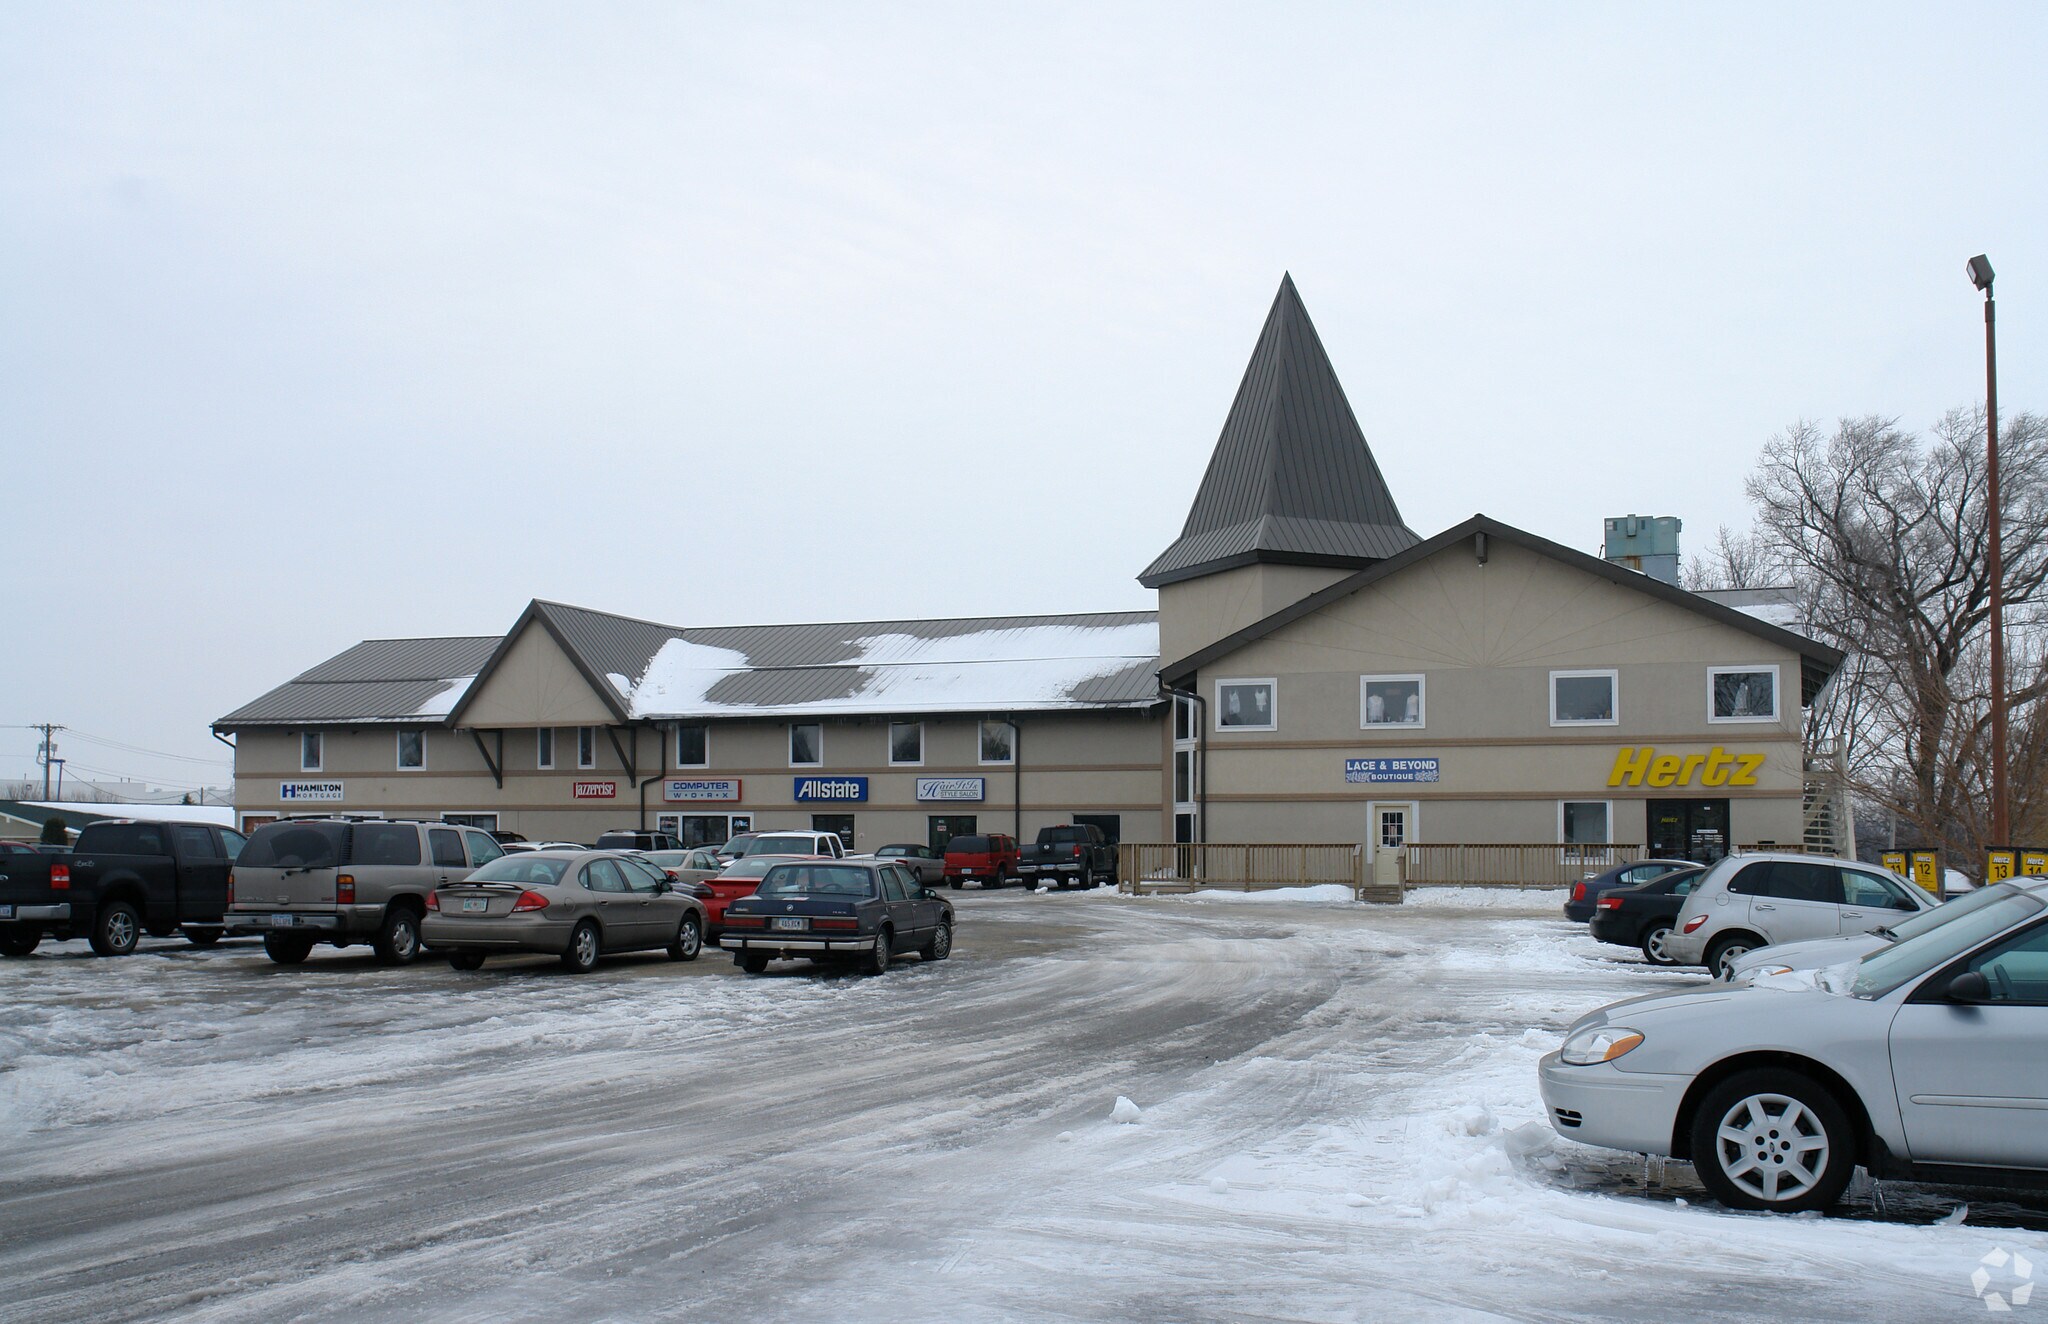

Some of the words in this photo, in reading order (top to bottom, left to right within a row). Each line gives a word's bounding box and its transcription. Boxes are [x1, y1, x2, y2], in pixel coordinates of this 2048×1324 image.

[1346, 761, 1376, 770] LACE
[1379, 761, 1387, 770] &
[1392, 760, 1437, 770] BEYOND
[1607, 746, 1766, 787] Hertz
[282, 784, 296, 798] H
[296, 784, 342, 792] HAMILTON
[575, 782, 614, 798] jazzercise
[673, 782, 729, 790] COMPUTER
[798, 780, 860, 798] Allstate
[1916, 855, 1932, 863] Hertz
[1992, 855, 2011, 864] Hertz
[2026, 857, 2045, 866] Hertz
[1890, 864, 1902, 874] 11
[1919, 863, 1931, 875] 12
[1994, 865, 2007, 878] 13
[2028, 866, 2042, 875] 14
